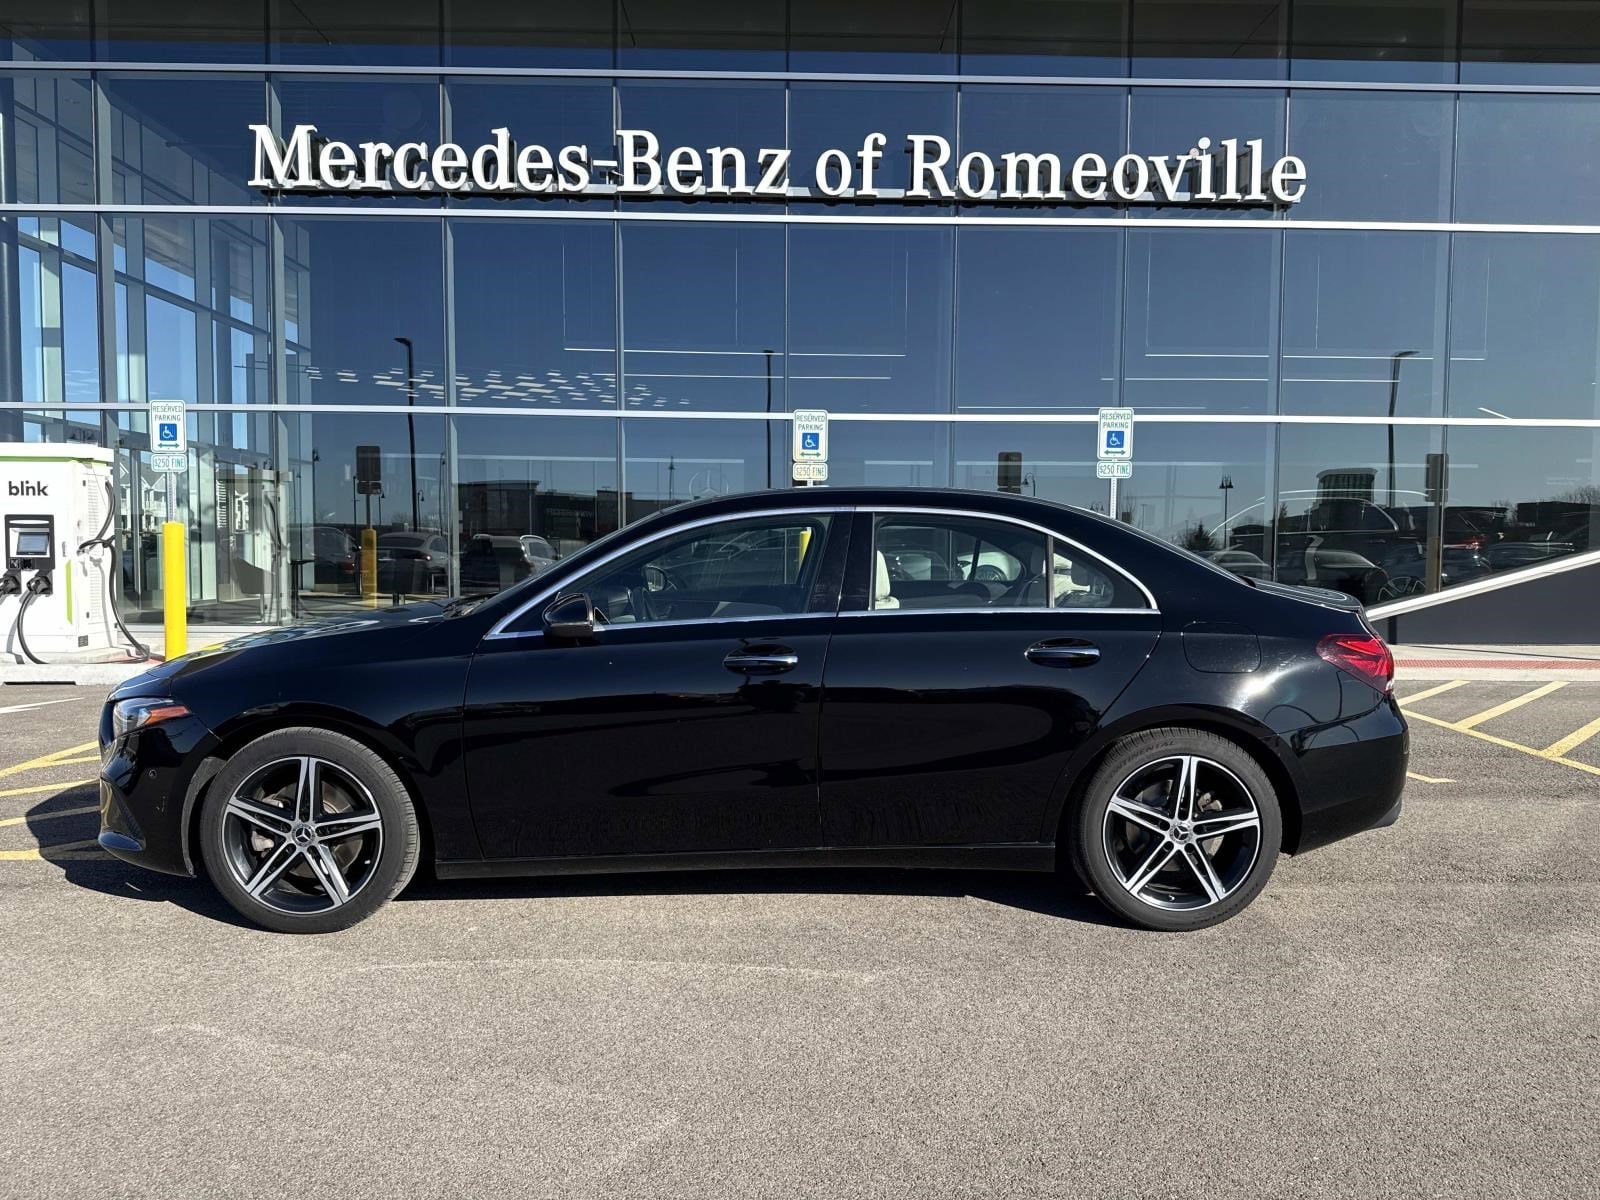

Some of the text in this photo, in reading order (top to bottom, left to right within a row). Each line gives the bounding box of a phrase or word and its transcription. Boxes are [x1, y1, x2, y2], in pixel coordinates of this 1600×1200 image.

[247, 124, 1307, 203] Mercedes-Benz of Romeoville
[796, 414, 825, 422] RESERVED
[1101, 412, 1131, 420] RESERVED
[797, 423, 824, 431] PARKING
[1102, 421, 1129, 429] PARKING
[154, 457, 185, 468] $250 FINE
[796, 466, 825, 477] $250 FINE
[1099, 464, 1129, 475] $250 FINE
[8, 480, 48, 496] blink
